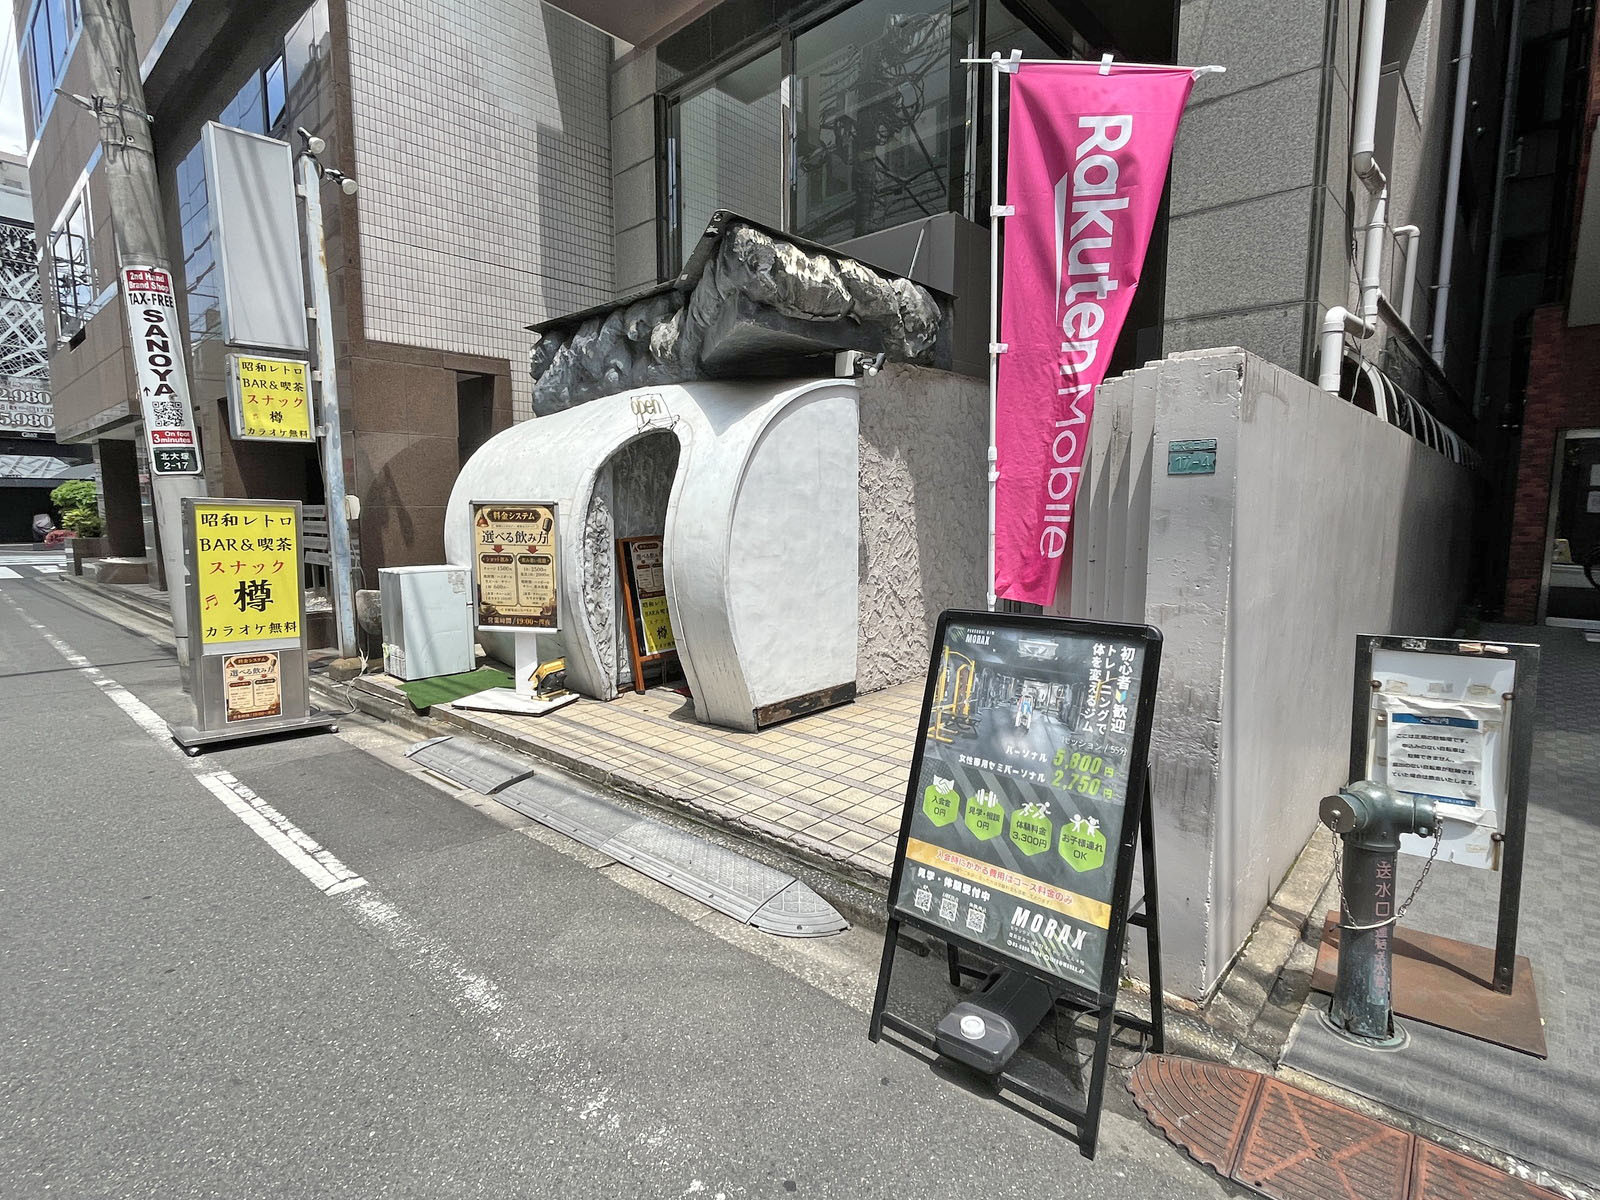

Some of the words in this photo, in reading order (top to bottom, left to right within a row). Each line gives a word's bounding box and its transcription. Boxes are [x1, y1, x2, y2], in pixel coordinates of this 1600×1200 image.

[1059, 115, 1133, 375] Rakuten
[130, 272, 143, 280] 2nd
[129, 281, 149, 289] Brand
[151, 282, 169, 292] Shop
[129, 292, 174, 307] TAX-FREE
[143, 309, 175, 396] SANOYA
[242, 361, 302, 375] 昭和レトロ
[242, 378, 304, 392] BAR&喫茶
[247, 394, 304, 408] スナック
[269, 411, 283, 423] 樽
[631, 399, 662, 424] open
[154, 433, 160, 443] 3
[247, 428, 308, 438] カラオケ無料
[164, 461, 188, 469] 2-17
[1041, 377, 1090, 559] Mobile
[1175, 456, 1210, 470] 17-4
[201, 513, 292, 528] 昭和レトロ
[493, 511, 535, 520] 料金システム
[200, 537, 292, 552] BAR&喫茶
[482, 530, 549, 545] 選べる飲み方
[209, 560, 285, 575] スナック
[233, 579, 274, 613] 樽
[205, 621, 297, 638] カラオケ無料
[965, 634, 990, 645] MORAX
[1117, 646, 1136, 690] 初心者
[1082, 643, 1106, 733] 体を変えるジム
[1096, 645, 1117, 735] トレーニングで
[1111, 703, 1128, 734] 歓迎
[1005, 745, 1048, 762] パーソナル
[959, 753, 1046, 783] 女性専用セミパーソナル
[1016, 820, 1047, 836] 体験料金
[1061, 834, 1103, 853] お子様連れ
[1073, 850, 1087, 860] OK
[1375, 861, 1392, 916] 送水口
[1010, 906, 1088, 951] MORAX
